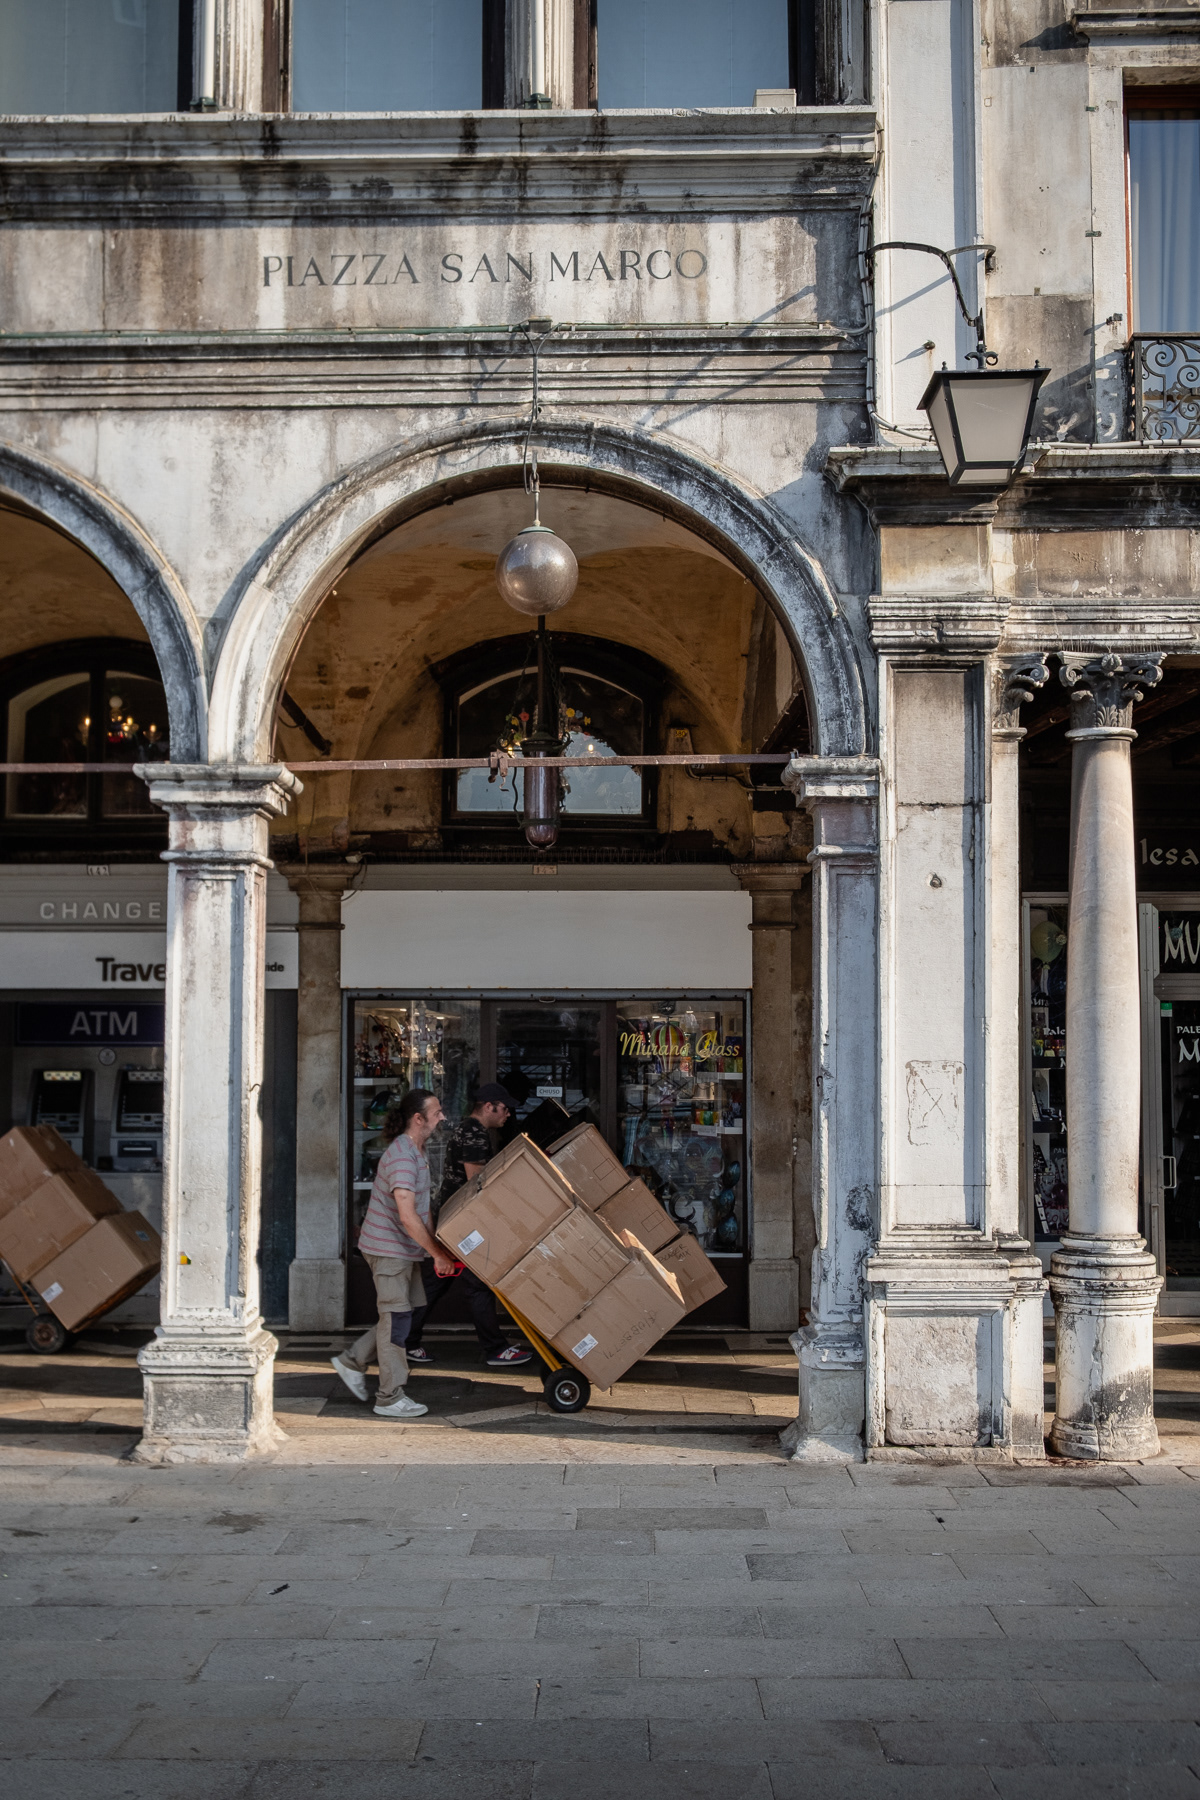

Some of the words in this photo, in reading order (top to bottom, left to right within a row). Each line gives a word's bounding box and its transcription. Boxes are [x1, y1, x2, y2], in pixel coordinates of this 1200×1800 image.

[263, 252, 420, 287] PIAZZA
[441, 251, 533, 284] SAN
[550, 249, 708, 282] MARCO
[1140, 838, 1200, 866] lesa
[40, 902, 162, 920] CHANGE
[95, 957, 166, 982] Trave
[69, 1011, 138, 1036] ATM
[620, 1032, 691, 1056] Murano
[695, 1030, 740, 1062] Glass
